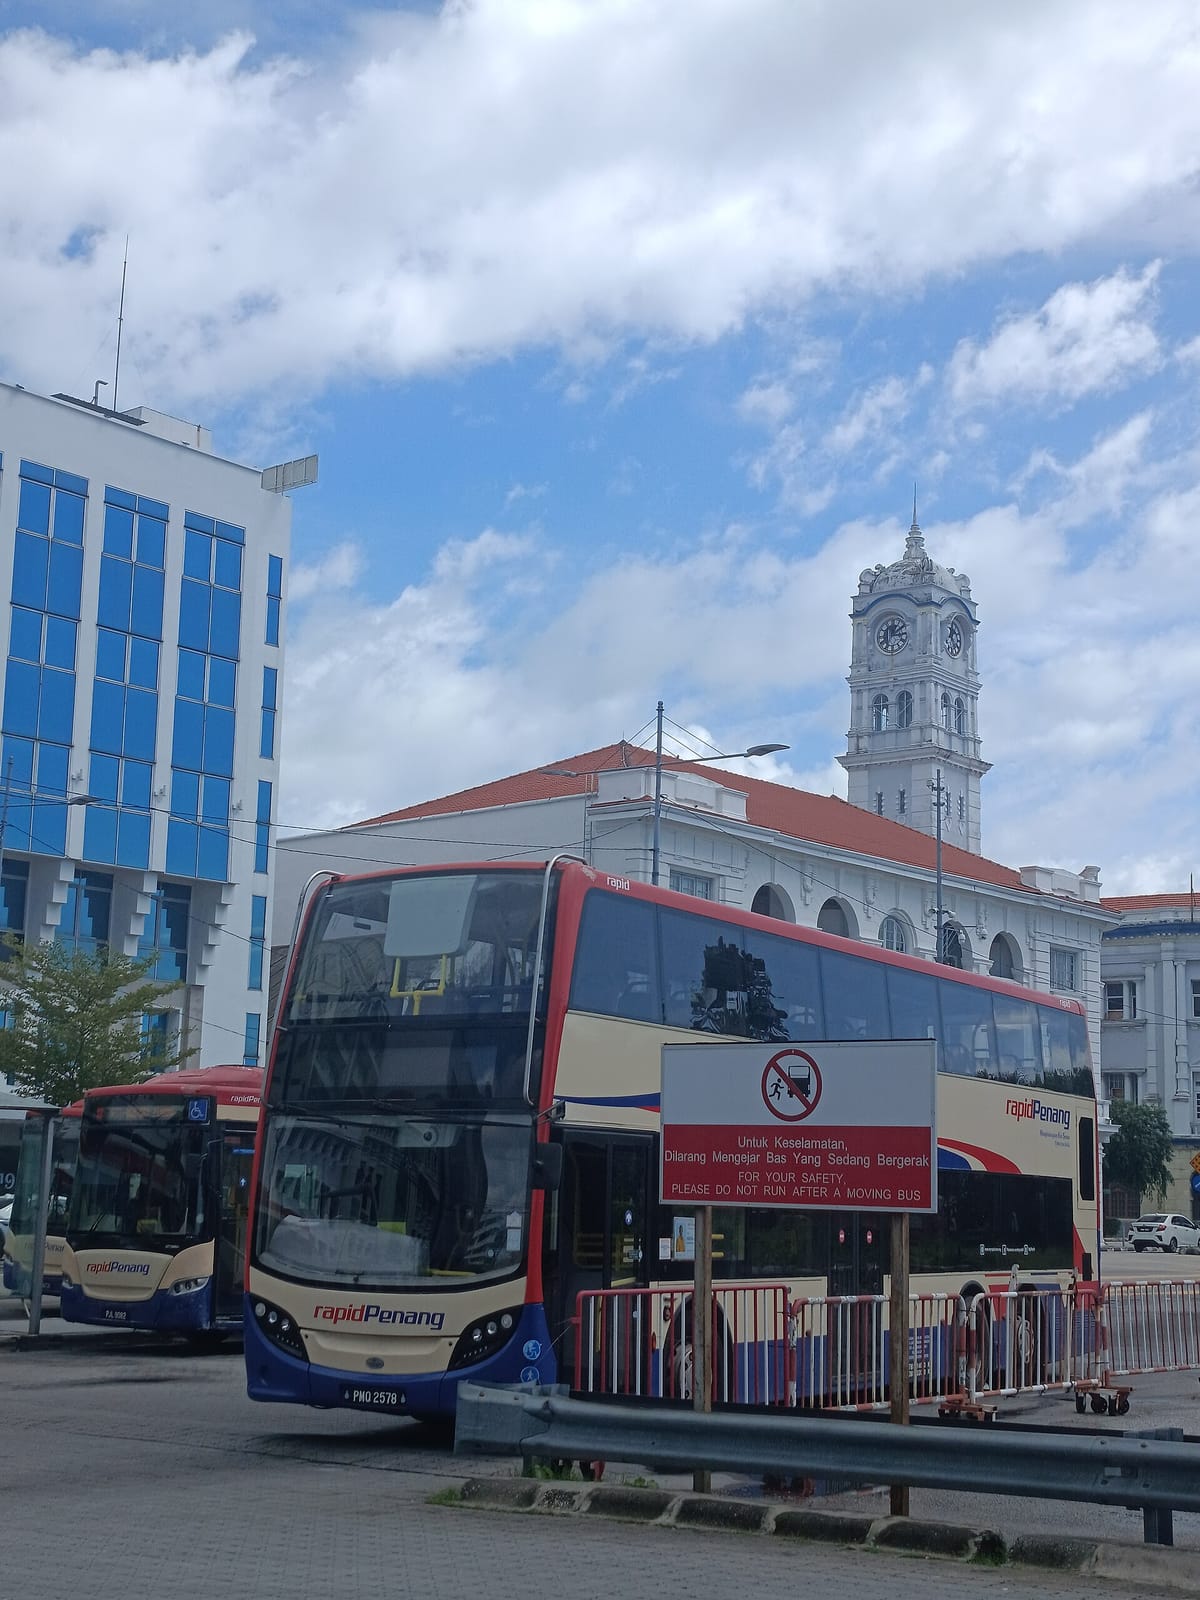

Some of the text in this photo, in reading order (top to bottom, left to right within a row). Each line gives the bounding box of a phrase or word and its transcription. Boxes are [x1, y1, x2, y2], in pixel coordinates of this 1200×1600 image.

[607, 877, 630, 891] rapid
[1006, 1098, 1070, 1130] rapidPenang
[738, 1136, 848, 1151] Untuk Keselamatan,
[664, 1150, 929, 1169] Dilarang Mengejar Bas Yang Sedang Bergerak
[738, 1171, 760, 1182] FOR
[765, 1172, 796, 1183] YOUR
[671, 1183, 921, 1201] PLEASE DO NOT RUN AFTER A MOVING BUS
[86, 1261, 151, 1276] rapidPenang
[313, 1303, 445, 1330] rapidPenang
[373, 1391, 397, 1405] 2578
